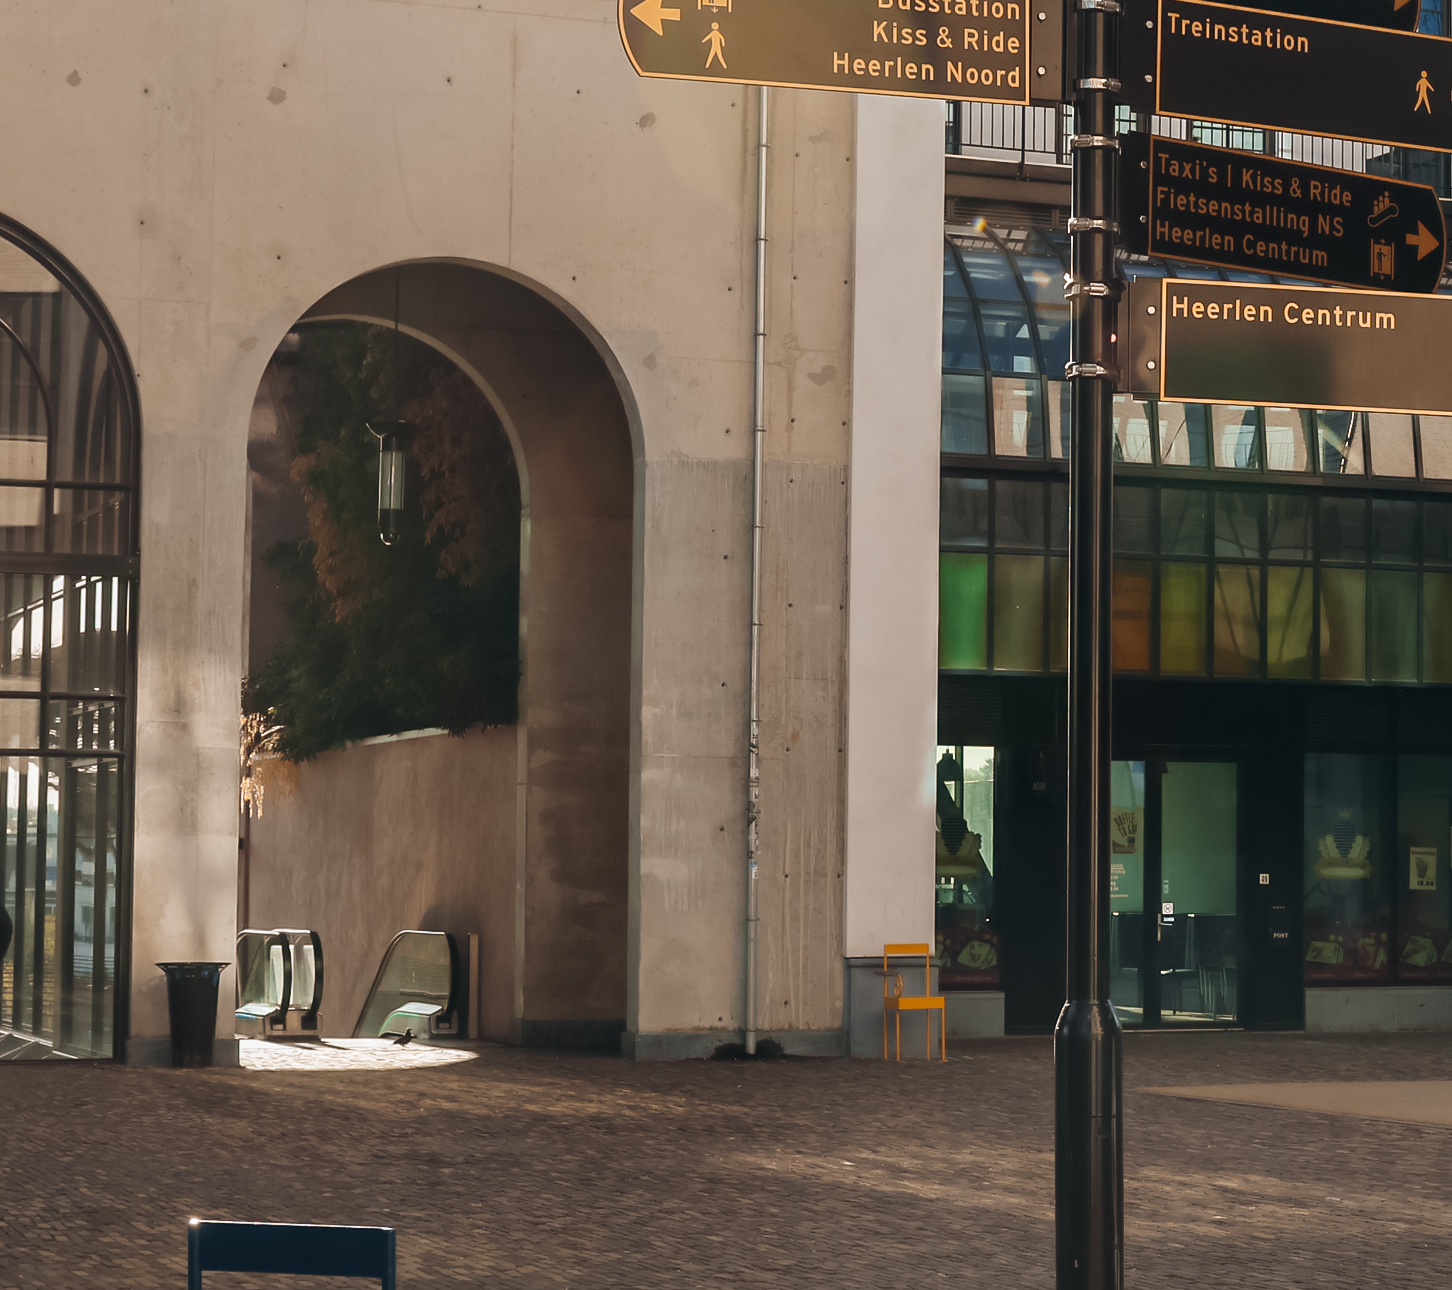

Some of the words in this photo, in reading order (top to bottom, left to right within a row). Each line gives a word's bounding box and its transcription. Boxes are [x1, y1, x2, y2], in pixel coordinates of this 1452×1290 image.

[872, 20, 928, 46] Kiss
[936, 26, 953, 48] &
[963, 28, 1020, 54] Ride
[1167, 12, 1309, 53] Treinstation
[832, 51, 935, 81] Heerlen
[946, 60, 1020, 88] Noord
[1157, 152, 1218, 183] Taxi's
[1242, 167, 1283, 195] Kiss
[1289, 177, 1302, 198] &
[1310, 180, 1352, 207] Ride
[1156, 186, 1310, 237] Fietsenstalling
[1317, 213, 1345, 237] NS
[1156, 219, 1235, 252] Heerlen
[1243, 234, 1328, 267] Centrum
[1171, 295, 1273, 323] Heerlen
[1283, 302, 1396, 330] Centrum
